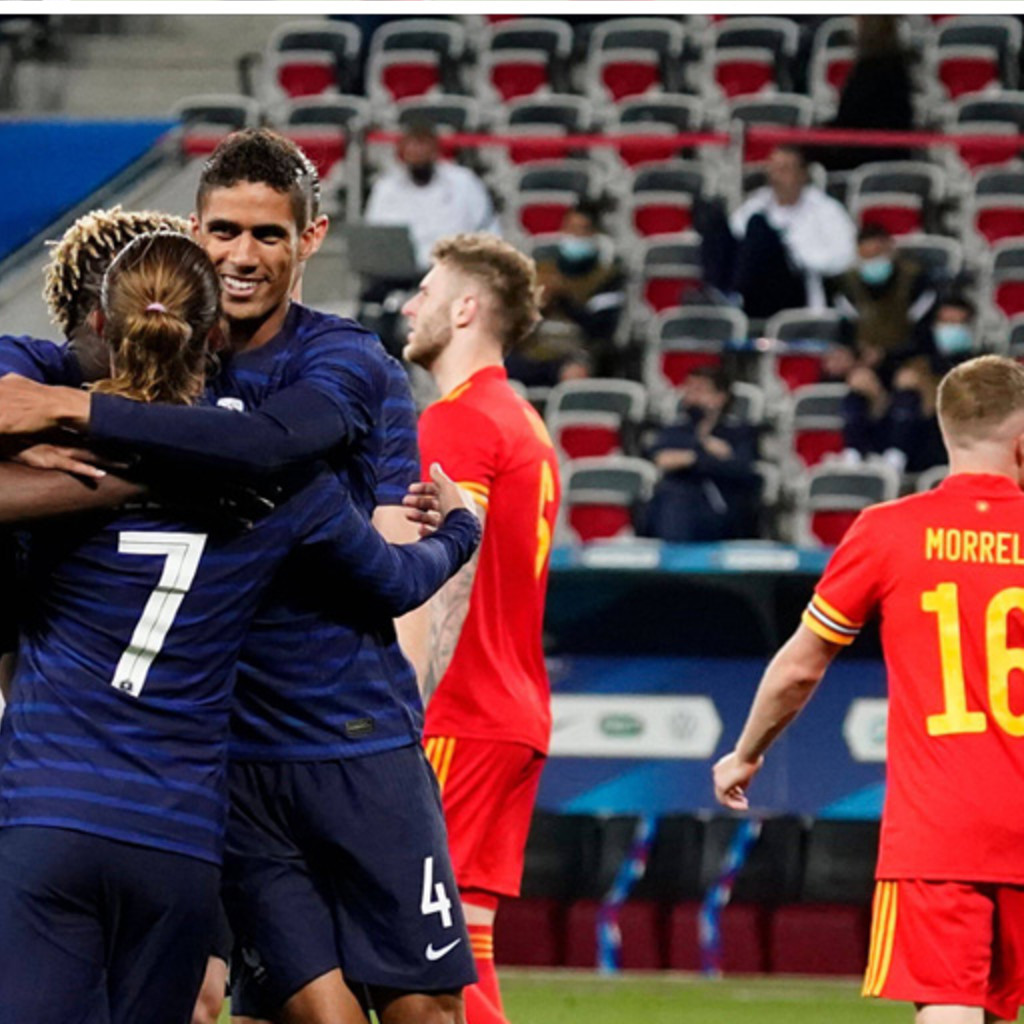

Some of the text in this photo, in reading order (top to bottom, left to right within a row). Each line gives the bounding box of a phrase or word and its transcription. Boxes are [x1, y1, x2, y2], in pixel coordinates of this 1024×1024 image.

[110, 531, 208, 698] 7
[921, 582, 1024, 737] 16
[421, 856, 453, 928] 4
